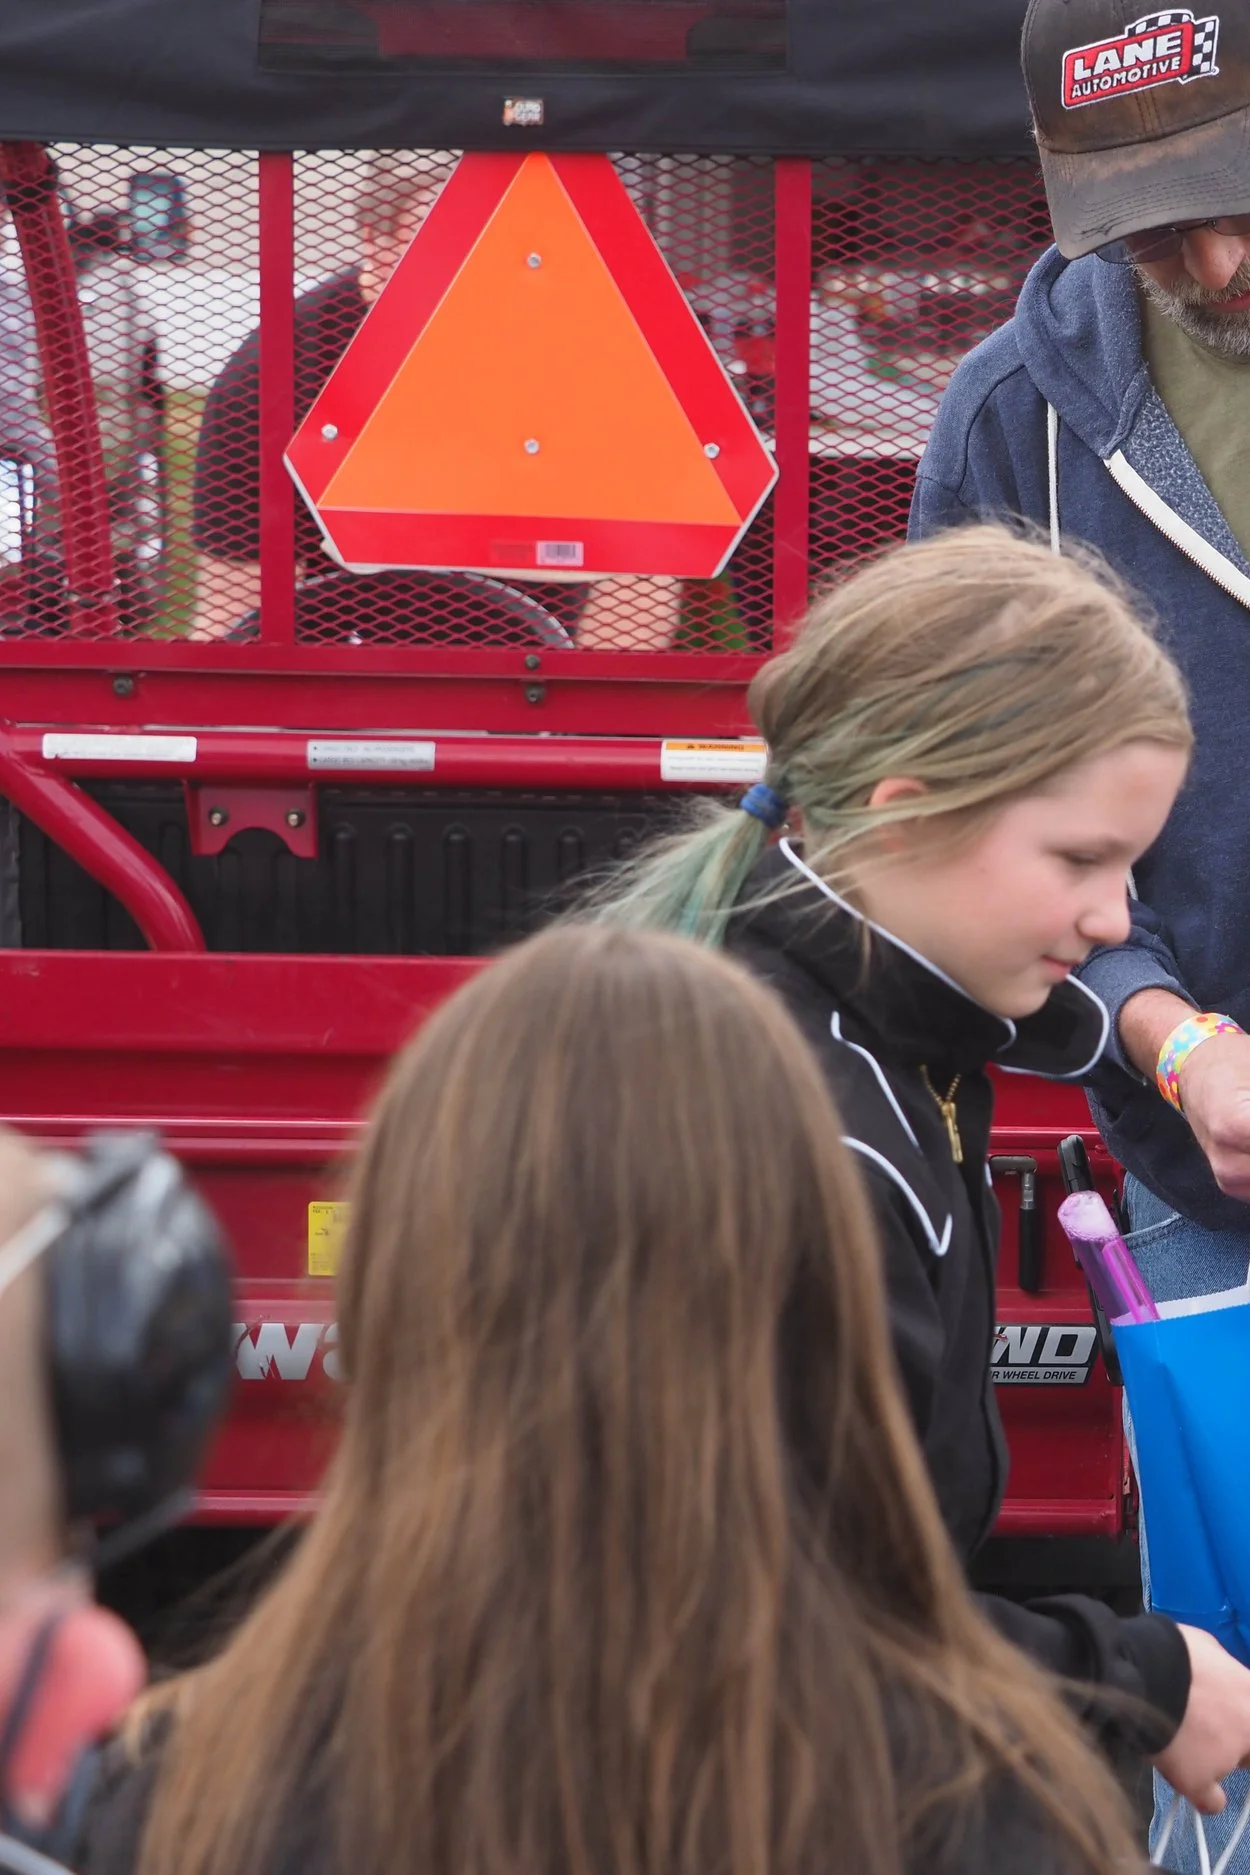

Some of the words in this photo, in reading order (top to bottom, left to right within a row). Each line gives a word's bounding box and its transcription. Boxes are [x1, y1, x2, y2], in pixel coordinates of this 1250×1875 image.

[1074, 31, 1182, 80] LANE
[1071, 56, 1181, 98] AUTOMOTIVE
[990, 1326, 1097, 1364] WD
[1002, 1370, 1040, 1380] WHEEL
[1043, 1370, 1077, 1380] DRIVE
